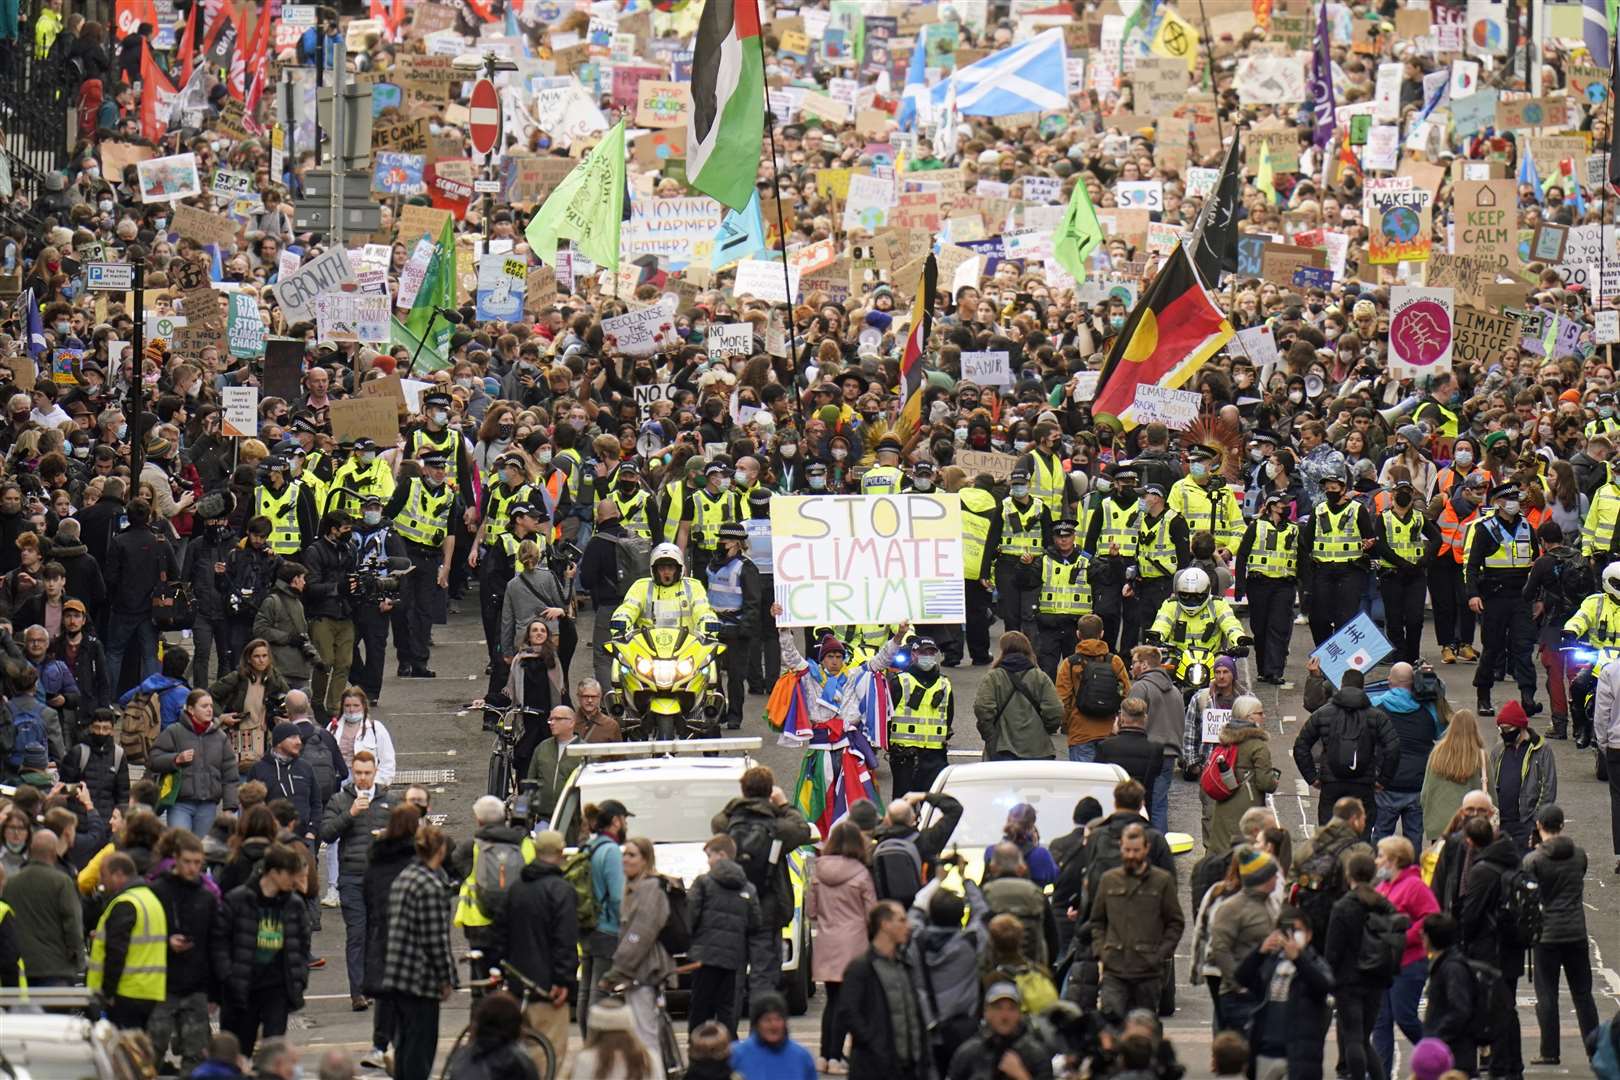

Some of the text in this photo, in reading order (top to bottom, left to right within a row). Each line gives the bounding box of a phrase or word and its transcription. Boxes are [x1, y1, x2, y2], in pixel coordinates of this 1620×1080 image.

[1373, 193, 1429, 206] WAKE UP
[1467, 211, 1505, 226] KEEP
[1463, 229, 1508, 243] CALM
[279, 252, 348, 308] GROWTH
[628, 322, 647, 333] THE
[1453, 310, 1515, 337] LIMATE
[619, 330, 654, 346] SYSTEM
[709, 326, 723, 338] NO
[231, 337, 263, 350] CHAOS
[719, 336, 749, 349] MORE
[635, 385, 662, 403] NO
[1136, 385, 1167, 399] CLIMATE
[792, 496, 947, 540] STOP
[777, 538, 956, 581] CLIMATE
[789, 576, 936, 622] CRIME
[1207, 711, 1221, 722] Our
